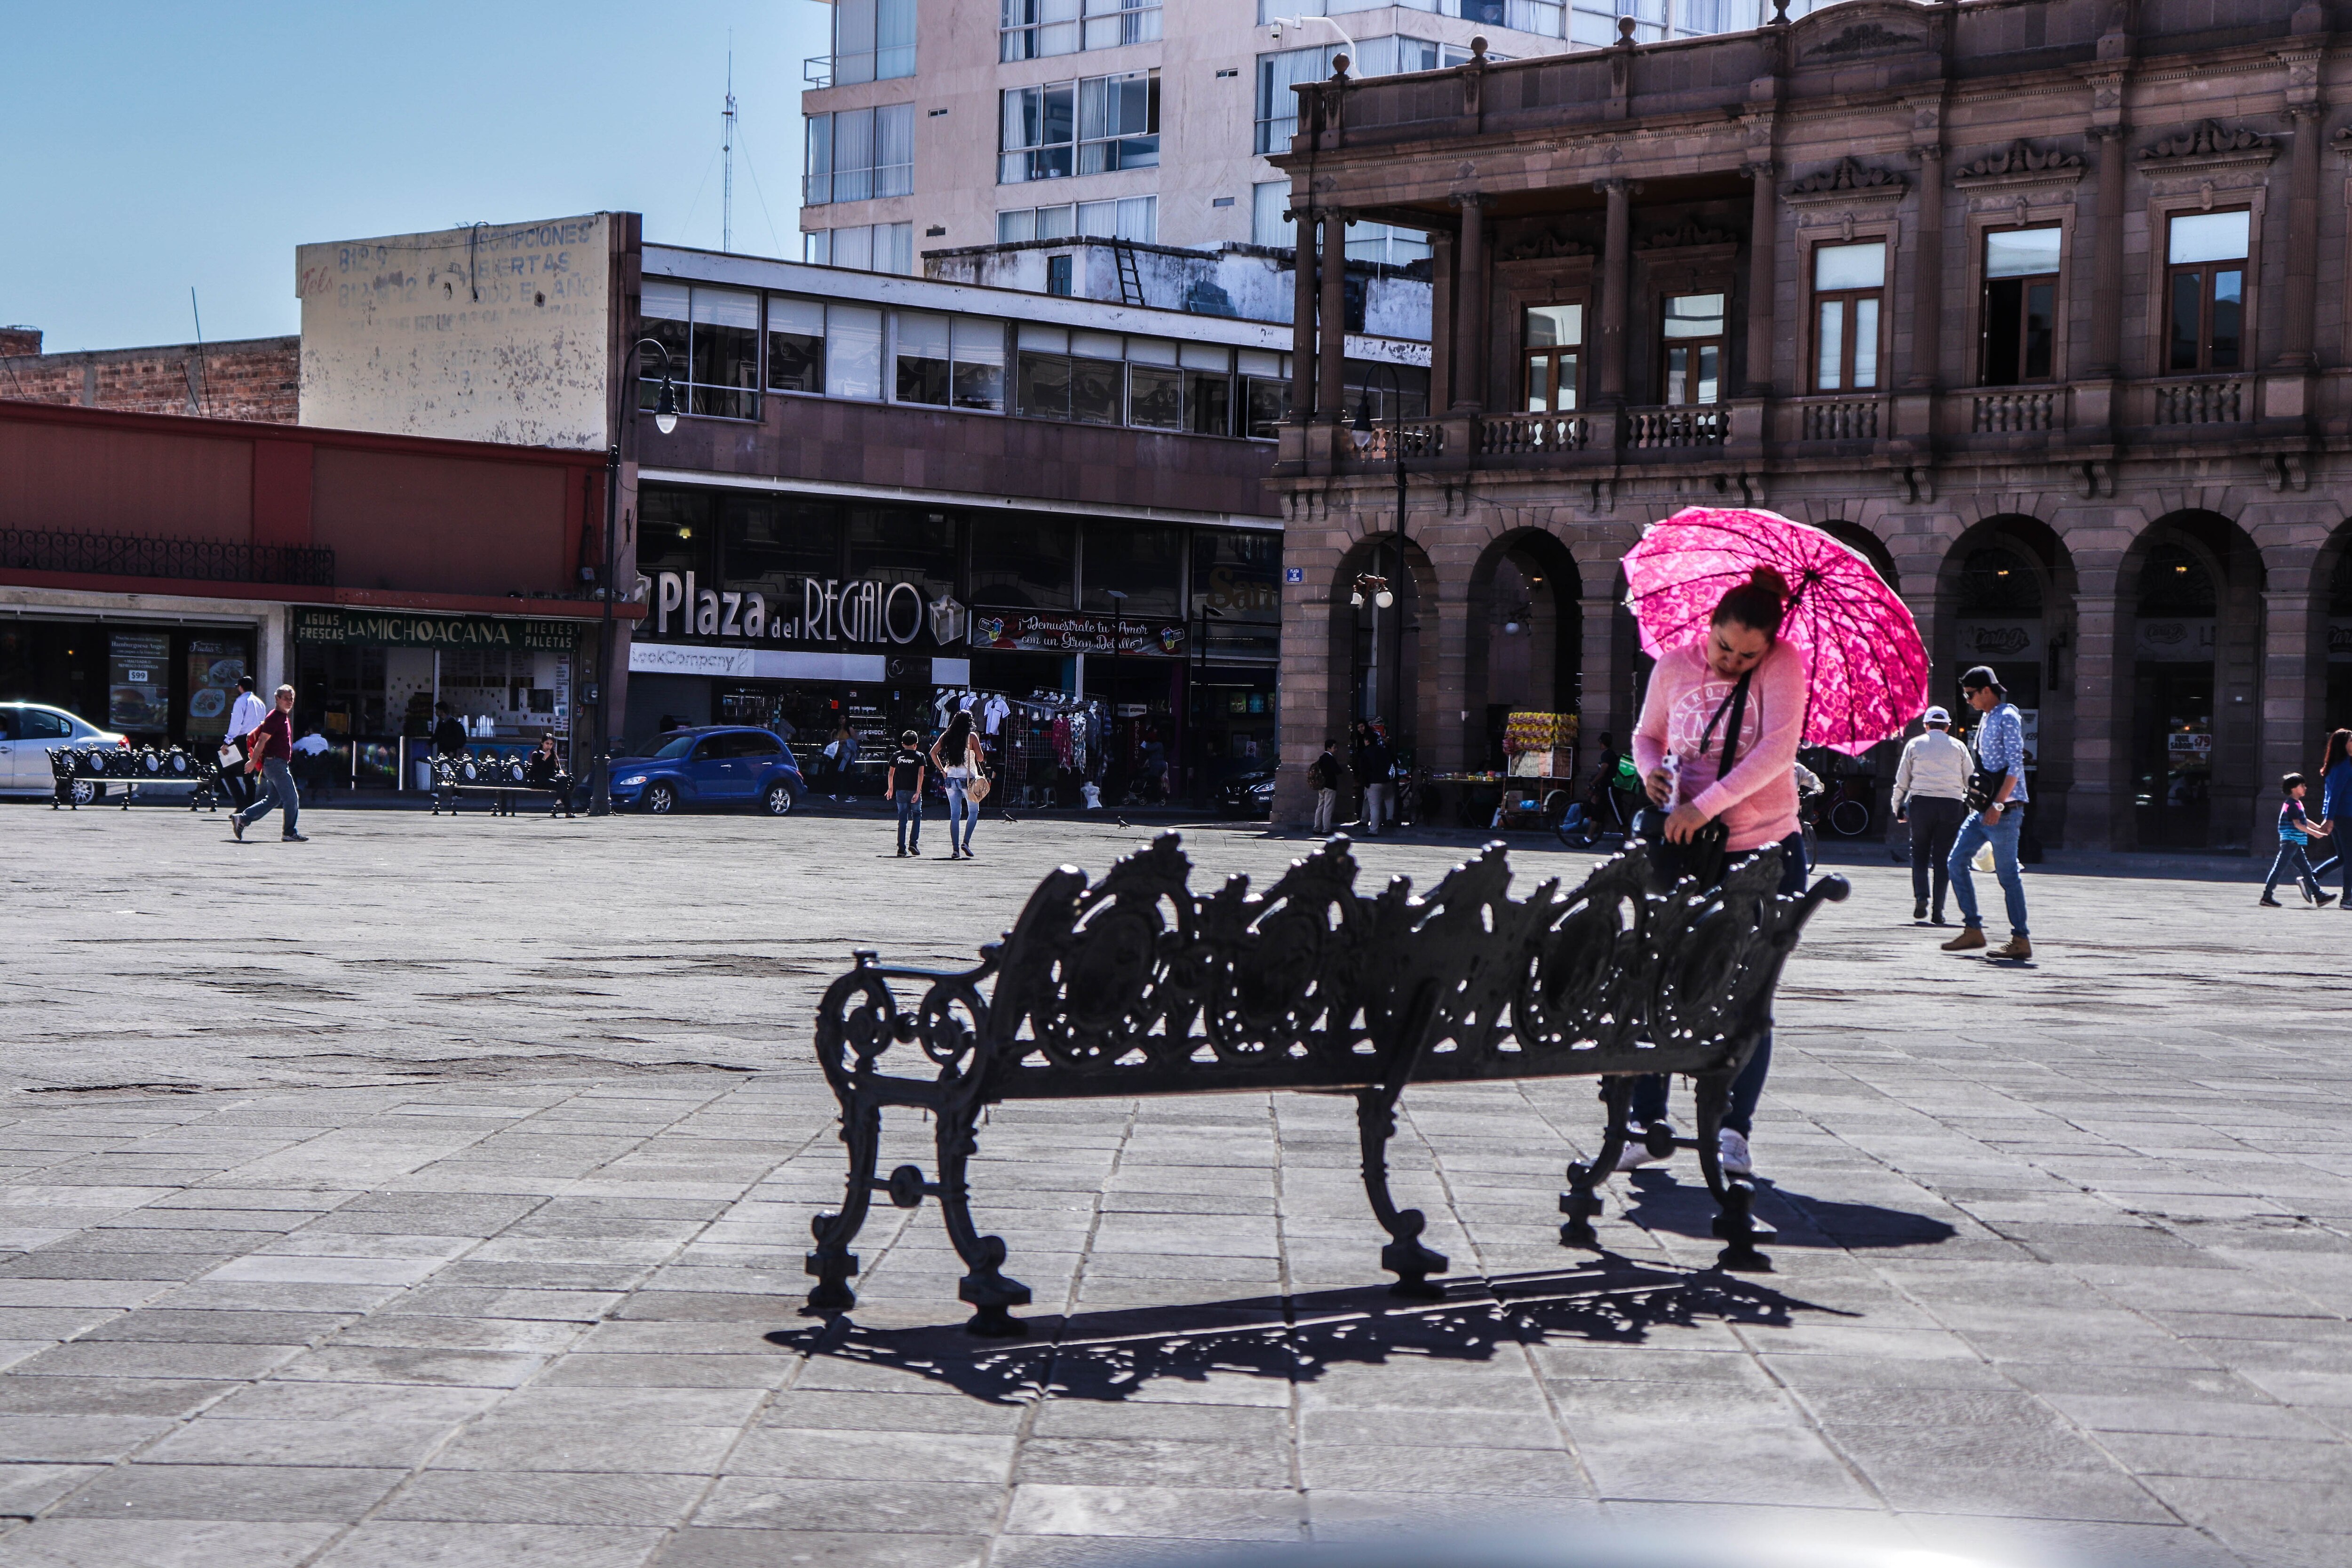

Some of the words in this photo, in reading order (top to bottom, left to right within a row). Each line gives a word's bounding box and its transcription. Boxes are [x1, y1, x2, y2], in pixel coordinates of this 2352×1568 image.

[464, 223, 590, 254] INSCRIPCIONES
[339, 247, 369, 274] 812
[466, 251, 571, 280] ABIERTAS
[551, 272, 594, 299] AÑO
[1206, 566, 1273, 611] San
[659, 571, 764, 637] Plaza
[771, 617, 799, 638] del
[804, 577, 922, 644] REGALO
[305, 613, 339, 626] AGUAS
[1097, 620, 1110, 633] tu
[1112, 621, 1149, 635] Amor
[300, 627, 343, 640] FRESCAS
[348, 620, 366, 636] LA
[367, 618, 511, 645] MICHOACANA
[526, 622, 572, 635] NIEVES
[525, 636, 572, 648] PALETAS
[1022, 636, 1041, 645] con
[1043, 637, 1058, 646] un
[1060, 631, 1093, 648] Gran
[2195, 735, 2210, 747] $79
[897, 755, 915, 764] Trevor
